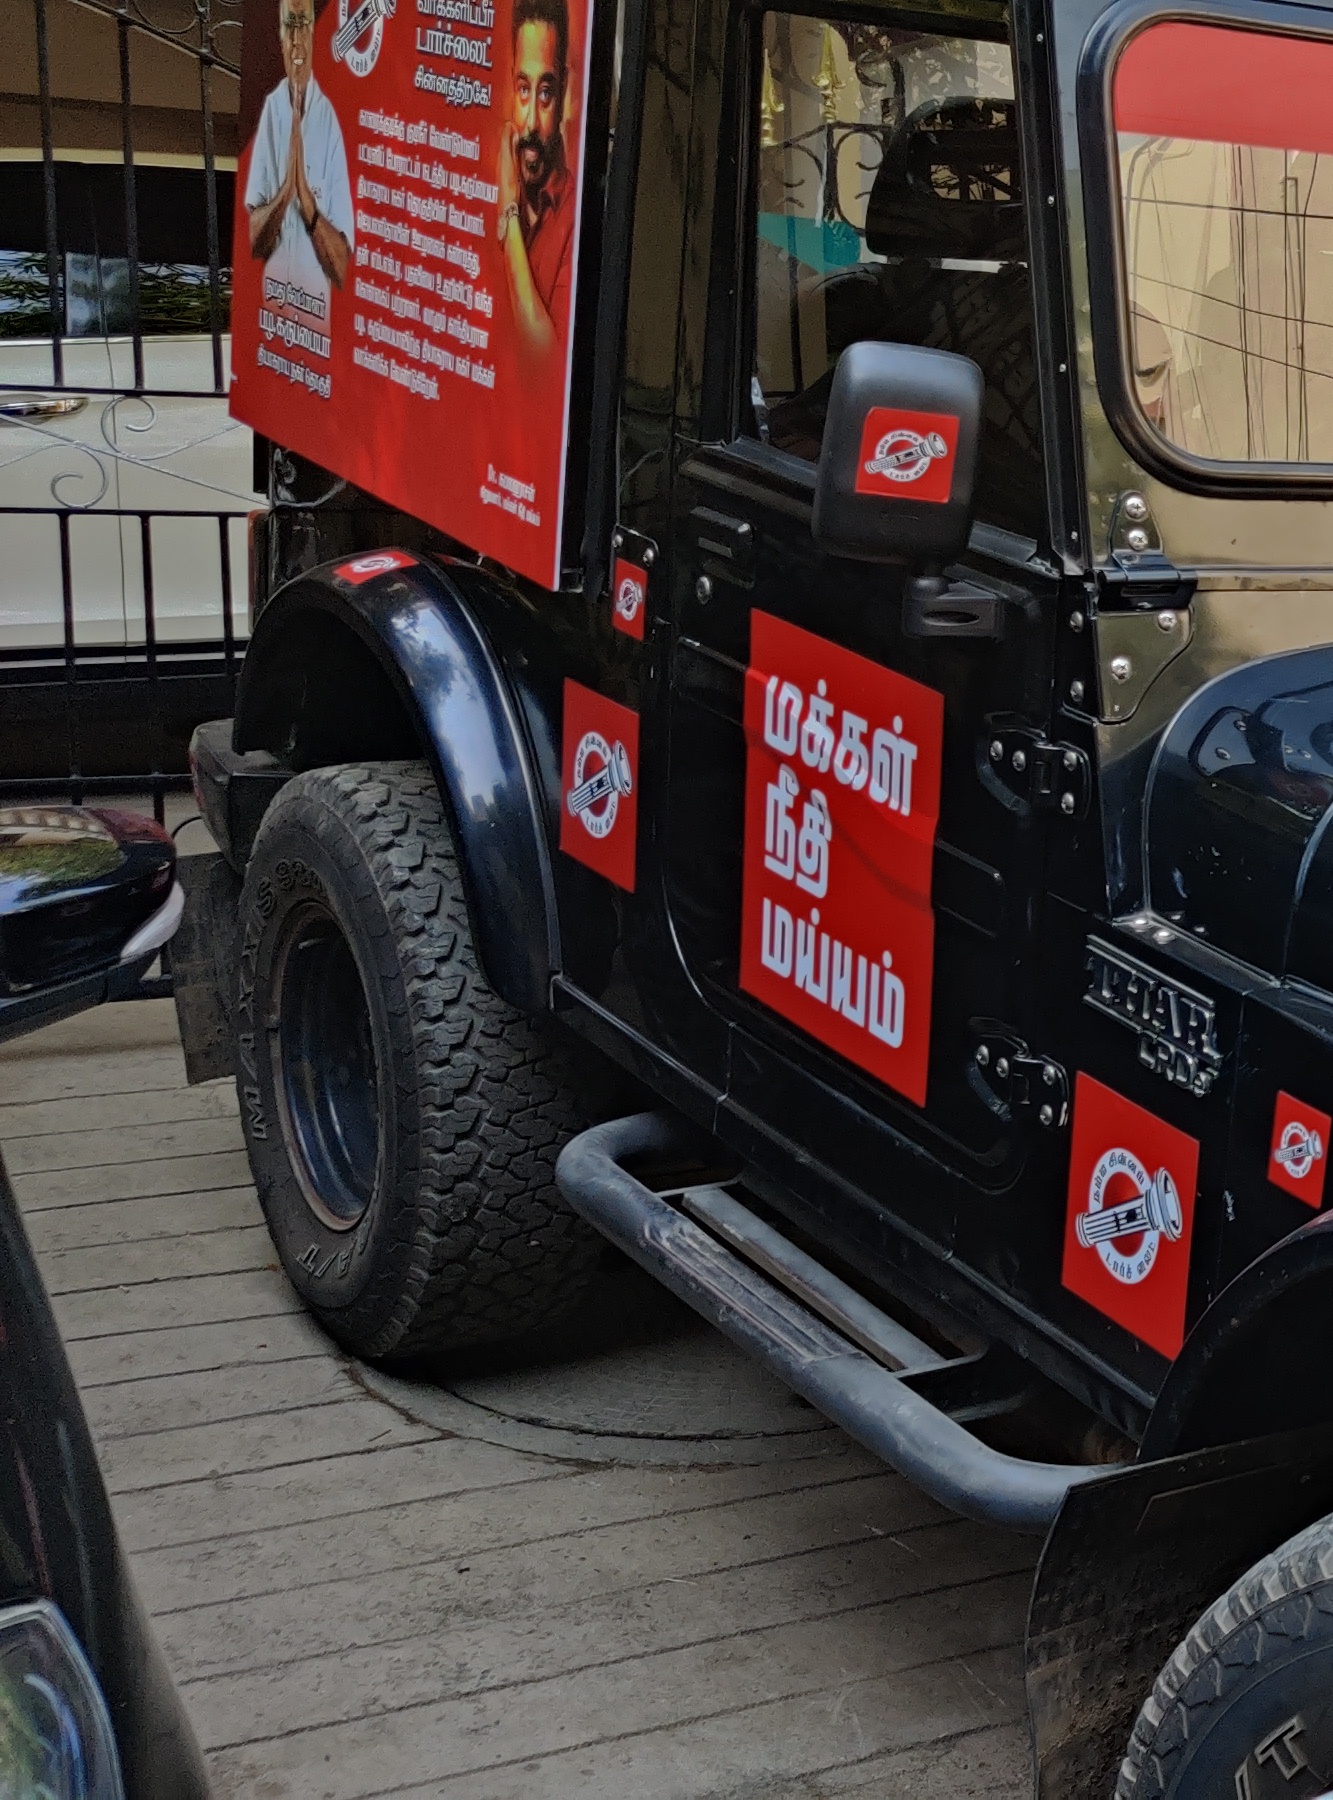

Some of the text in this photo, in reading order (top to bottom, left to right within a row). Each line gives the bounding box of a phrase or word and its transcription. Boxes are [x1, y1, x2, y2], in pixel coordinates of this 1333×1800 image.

[415, 63, 492, 108] சின்னத்திற்கே!
[416, 20, 493, 68] டார்ச்லைட்
[764, 675, 917, 817] மக்கள்
[764, 763, 832, 899] நீதி
[761, 897, 905, 1049] மய்யம்
